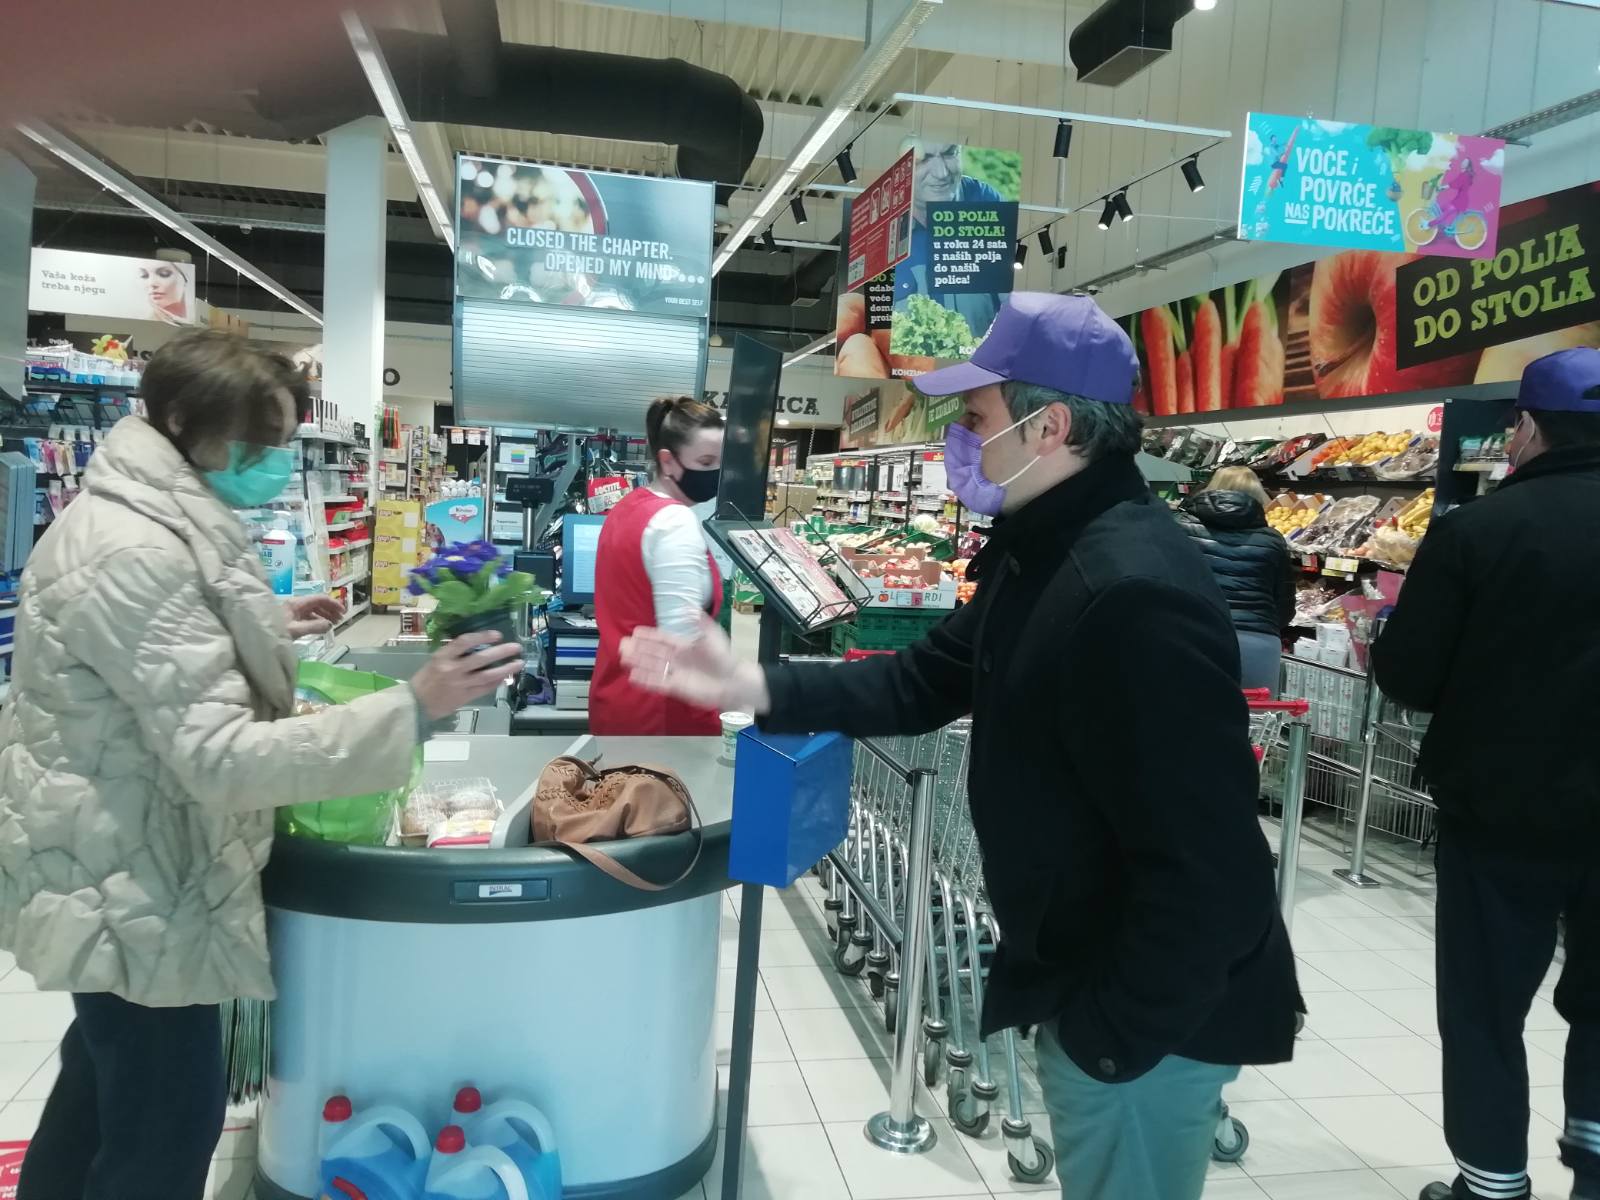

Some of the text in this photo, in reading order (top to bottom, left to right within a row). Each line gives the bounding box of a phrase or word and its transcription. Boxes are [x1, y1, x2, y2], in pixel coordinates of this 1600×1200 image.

[1296, 145, 1359, 177] VOĆE i
[1300, 175, 1377, 208] POVRĆE
[932, 211, 999, 222] OD POLJA
[1284, 202, 1310, 219] NAS
[1312, 204, 1395, 236] POKREĆE
[933, 226, 1005, 237] DO STOLA!
[507, 227, 673, 260] CLOSED THE CHAPTER.
[934, 240, 1008, 249] u roku 24 sata
[934, 251, 1002, 264] s naših polja
[546, 253, 604, 275] OPENED
[609, 260, 631, 277] MY
[934, 263, 980, 273] do naših
[1413, 224, 1585, 307] OD POLJA
[41, 269, 96, 283] Vaša koža
[934, 275, 970, 288] polica!
[41, 281, 106, 295] treba njegu
[870, 293, 891, 303] voće
[1413, 266, 1596, 347] DO STOLA
